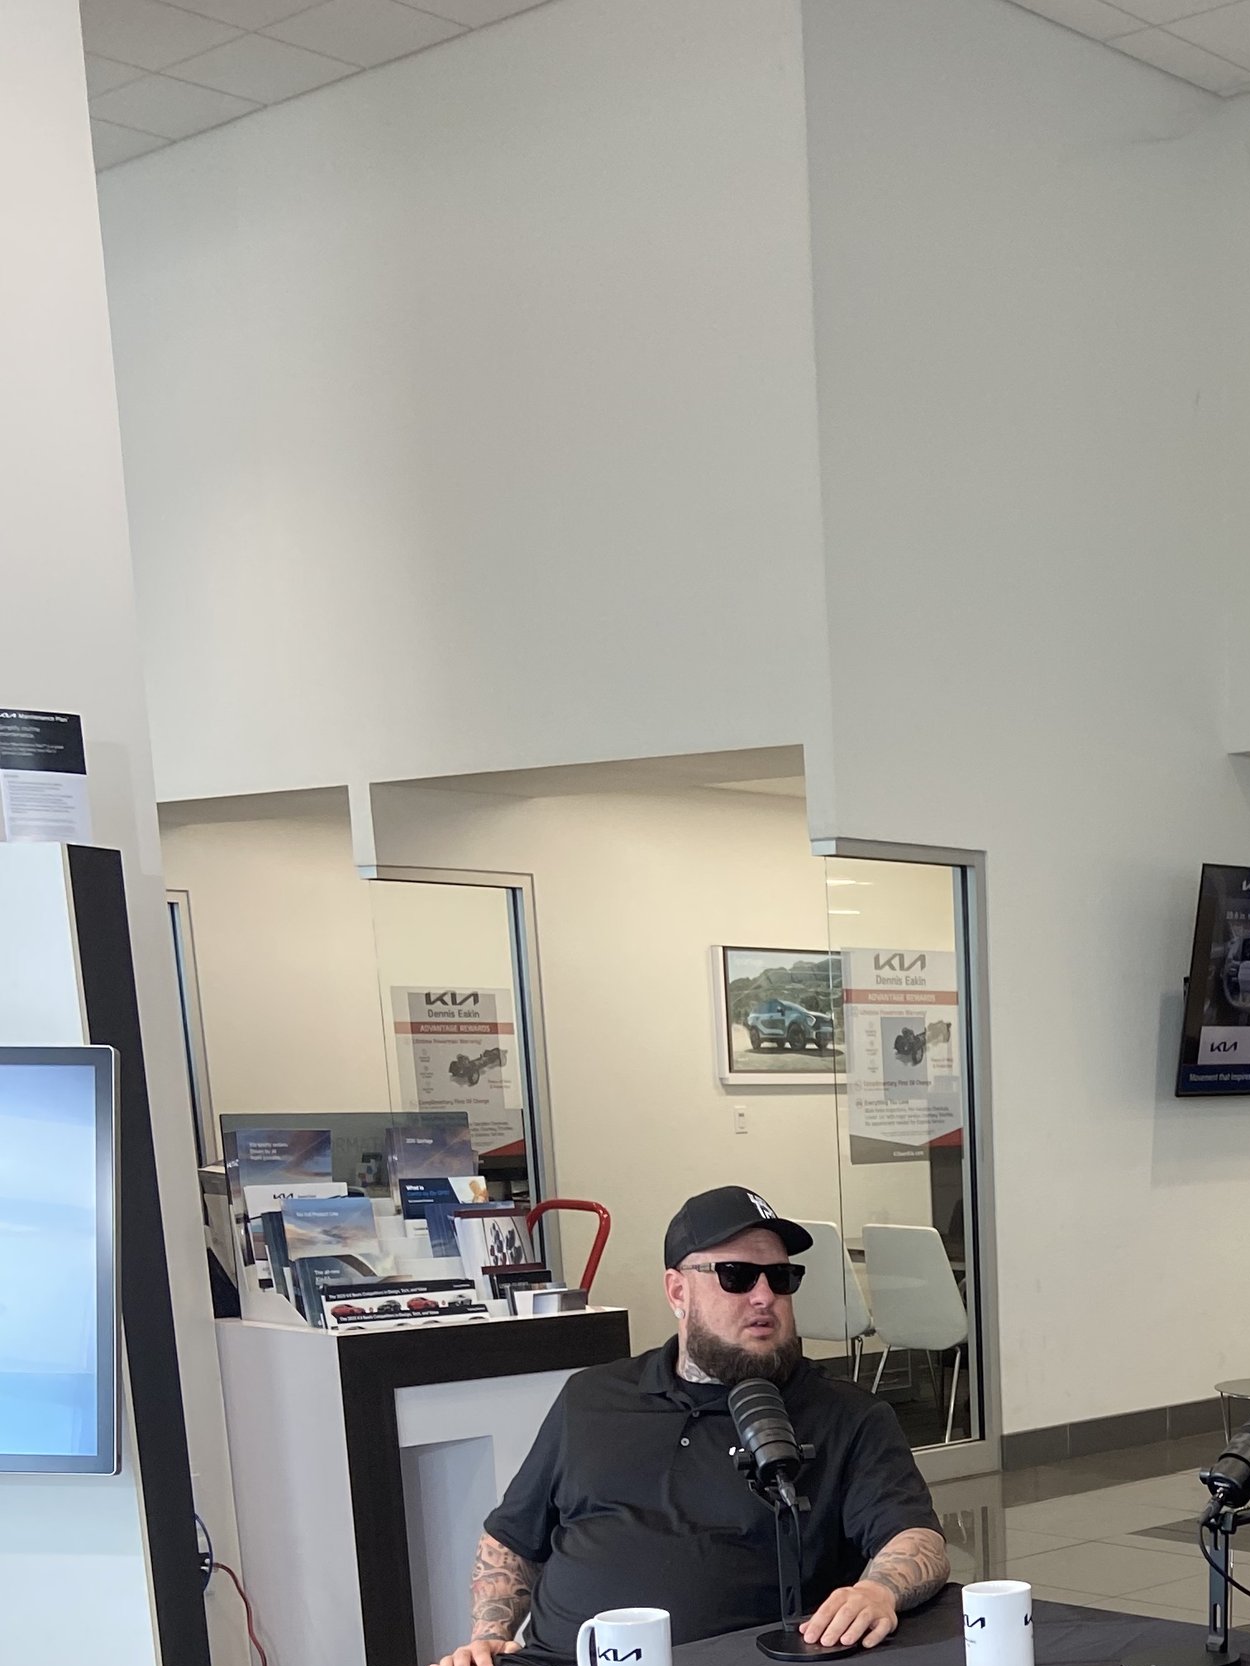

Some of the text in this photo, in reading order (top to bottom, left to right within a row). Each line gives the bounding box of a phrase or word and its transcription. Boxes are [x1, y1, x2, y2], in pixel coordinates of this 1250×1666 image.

[874, 953, 927, 972] KIA
[875, 974, 927, 986] Dennis Eakin
[425, 991, 480, 1006] KIA
[868, 993, 905, 1002] ADVANTAGE
[427, 1009, 480, 1019] Dennis Eakin
[419, 1025, 459, 1033] ADVANTAGE
[1210, 1041, 1238, 1052] KIA
[598, 1646, 643, 1662] KIA
